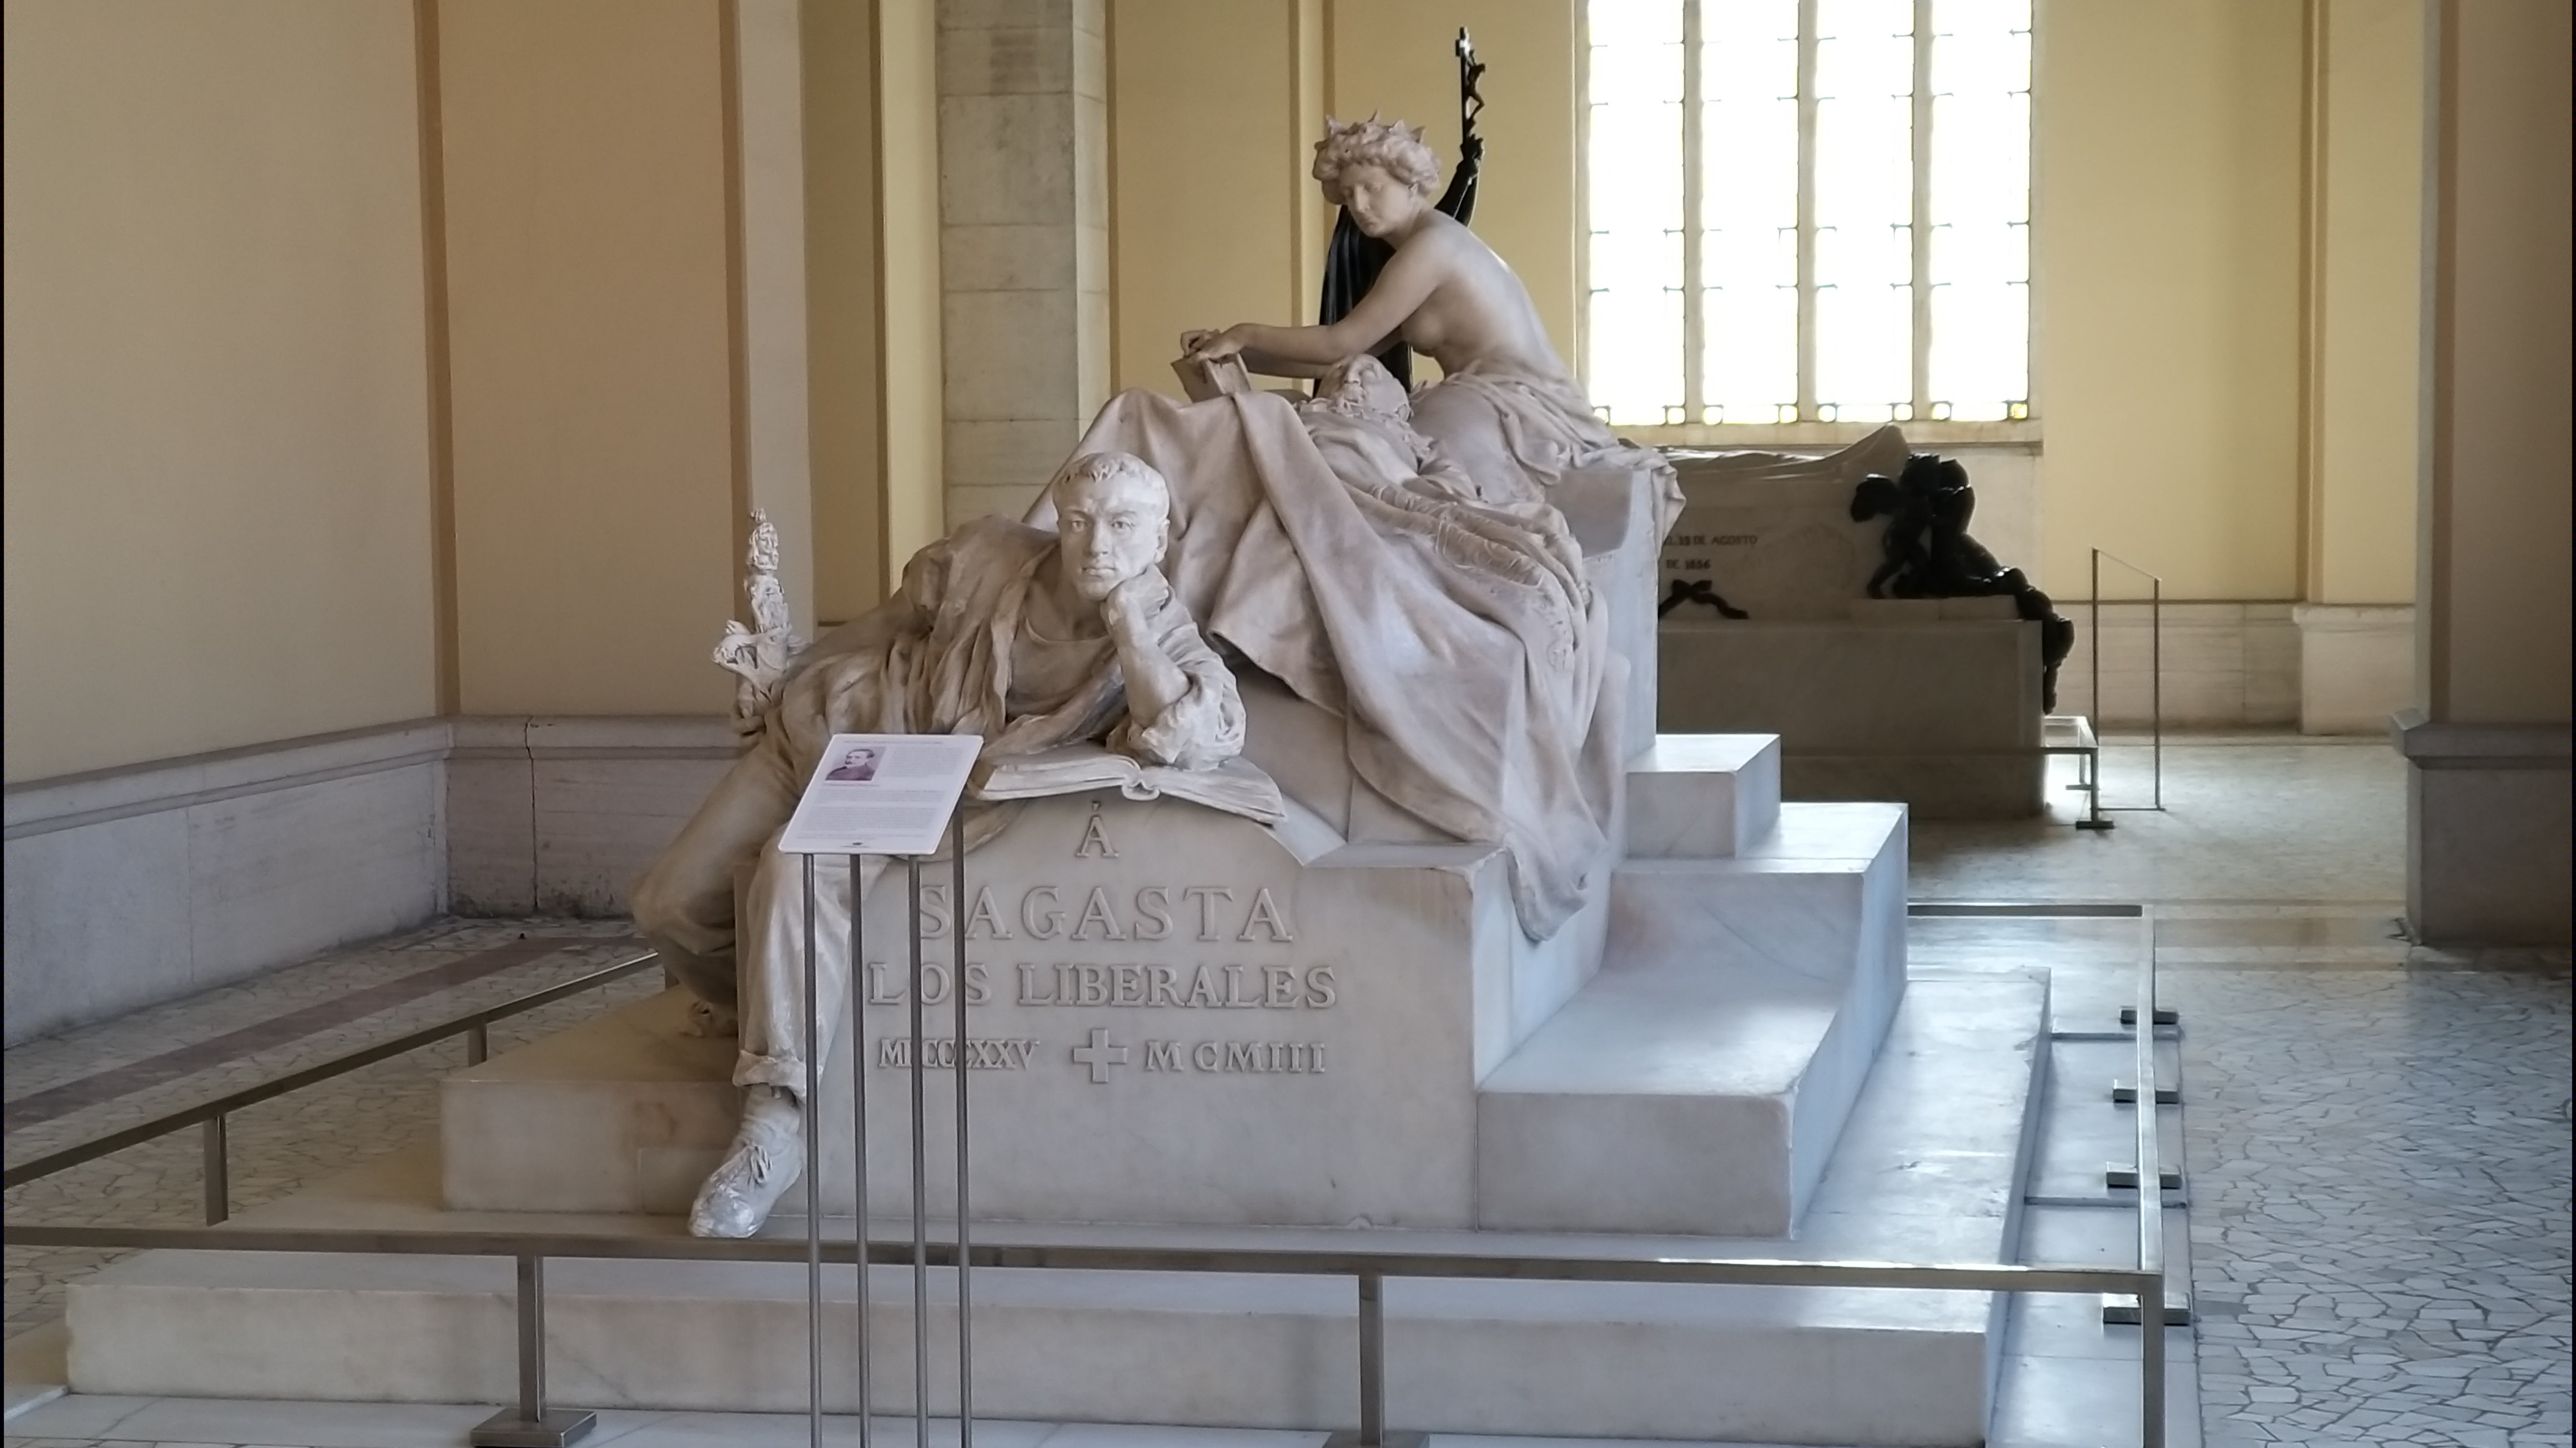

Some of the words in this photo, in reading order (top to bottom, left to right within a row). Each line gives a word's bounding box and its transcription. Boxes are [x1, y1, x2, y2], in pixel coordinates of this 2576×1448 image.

[1712, 535, 1758, 545] AGOSTO
[920, 884, 1293, 942] SAGASTA
[869, 962, 992, 1006] LOS
[1017, 963, 1337, 1008] LIBERALES
